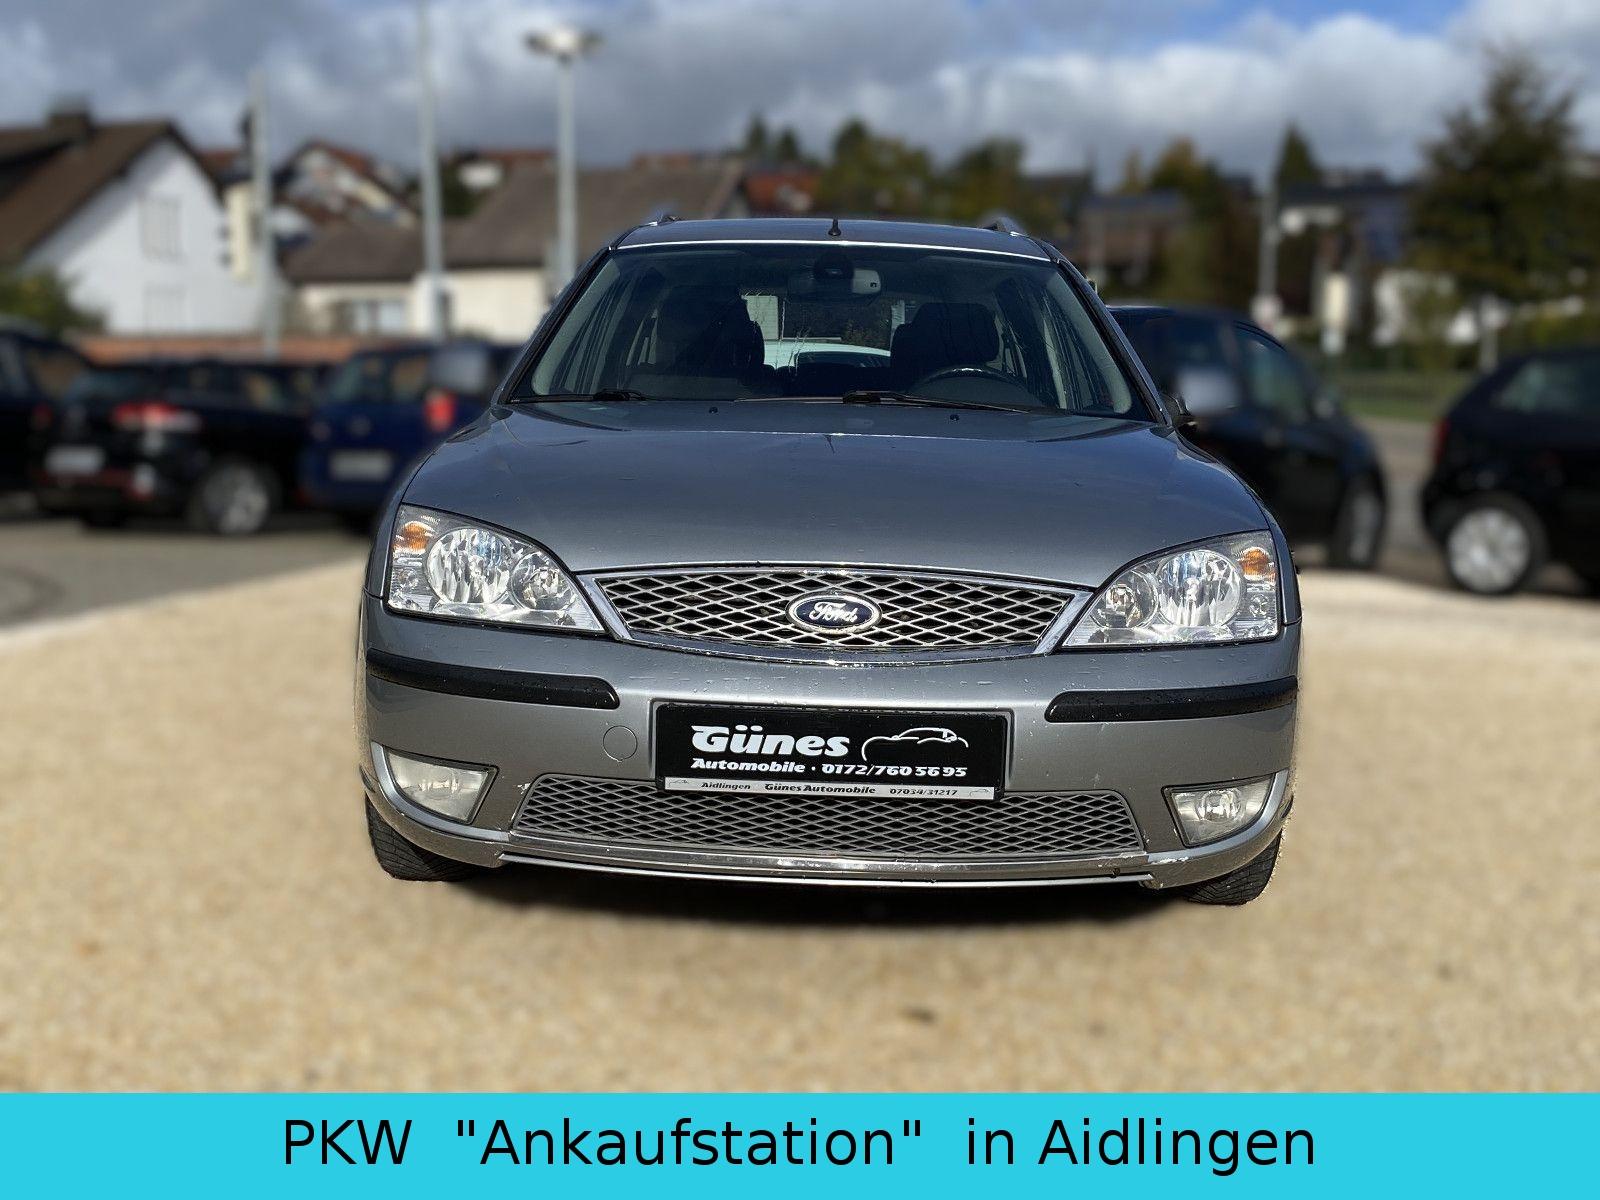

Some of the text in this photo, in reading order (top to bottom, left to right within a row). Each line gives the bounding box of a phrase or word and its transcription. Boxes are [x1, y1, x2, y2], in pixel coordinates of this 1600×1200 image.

[809, 601, 858, 622] Ford
[691, 725, 850, 757] Günes
[691, 758, 968, 778] Automobile 0172/760 56 95
[701, 782, 958, 797] Aidlingen Günes Automobile 07034/31217
